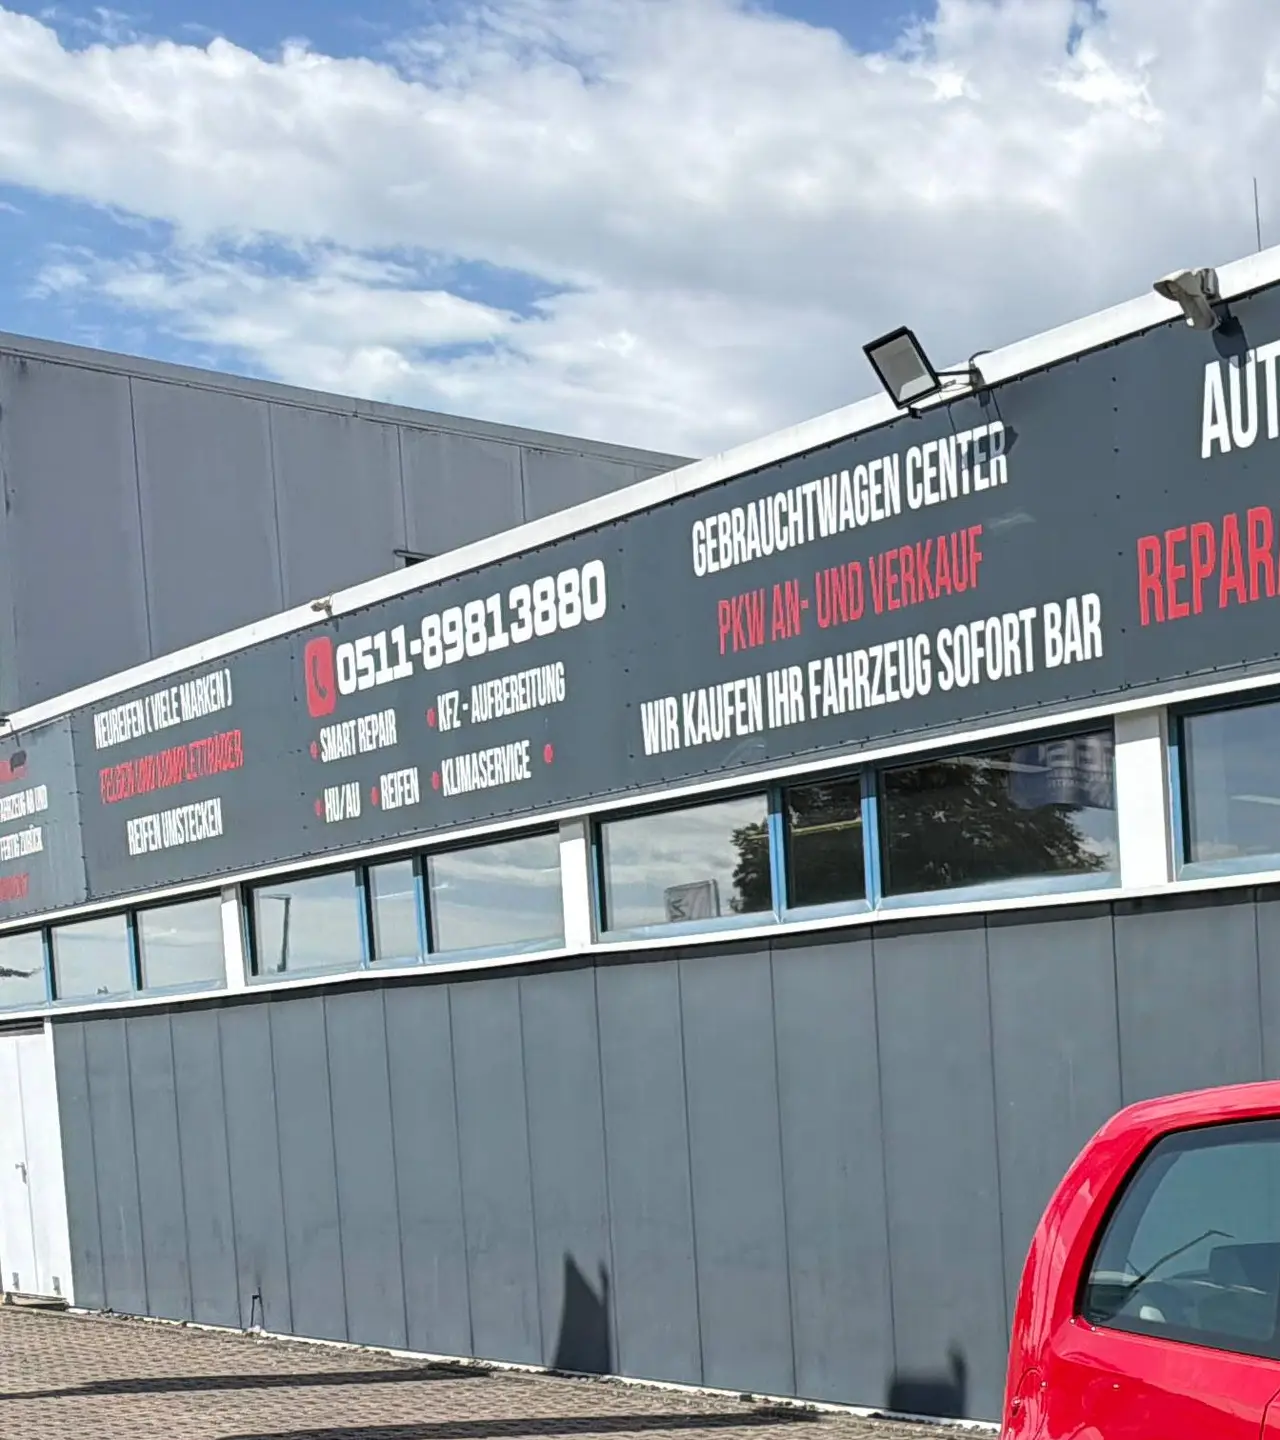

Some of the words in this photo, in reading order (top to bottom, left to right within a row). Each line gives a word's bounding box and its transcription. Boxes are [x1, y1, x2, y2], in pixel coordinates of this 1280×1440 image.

[692, 453, 899, 576] GEBRAUCHTWAGEN
[906, 421, 1007, 509] CENTER
[718, 589, 765, 655] PKW
[772, 579, 809, 642] AN-
[815, 560, 863, 628] UND
[869, 525, 983, 616] VERKAUF
[336, 560, 606, 695] 0511-89813880
[94, 699, 145, 750] NEUREIFEN
[180, 670, 225, 721] MARKEN
[437, 690, 461, 732] KFZ
[471, 661, 565, 724] AUFBEREITUNG
[641, 696, 679, 756] WIR
[683, 674, 762, 747] KAUFEN
[768, 664, 805, 729] IHR
[809, 633, 931, 719] FAHRZEUG
[937, 607, 1037, 691] SOFORT
[1043, 593, 1103, 668] BAR
[320, 718, 356, 762] SMART
[358, 708, 397, 752] REPAIR
[441, 740, 532, 796] KLIMASERVICE
[324, 782, 361, 822] HU/AU
[380, 767, 420, 810] REIFEN
[127, 813, 162, 855] REIFEN
[161, 797, 223, 848] UMSTECKEN
